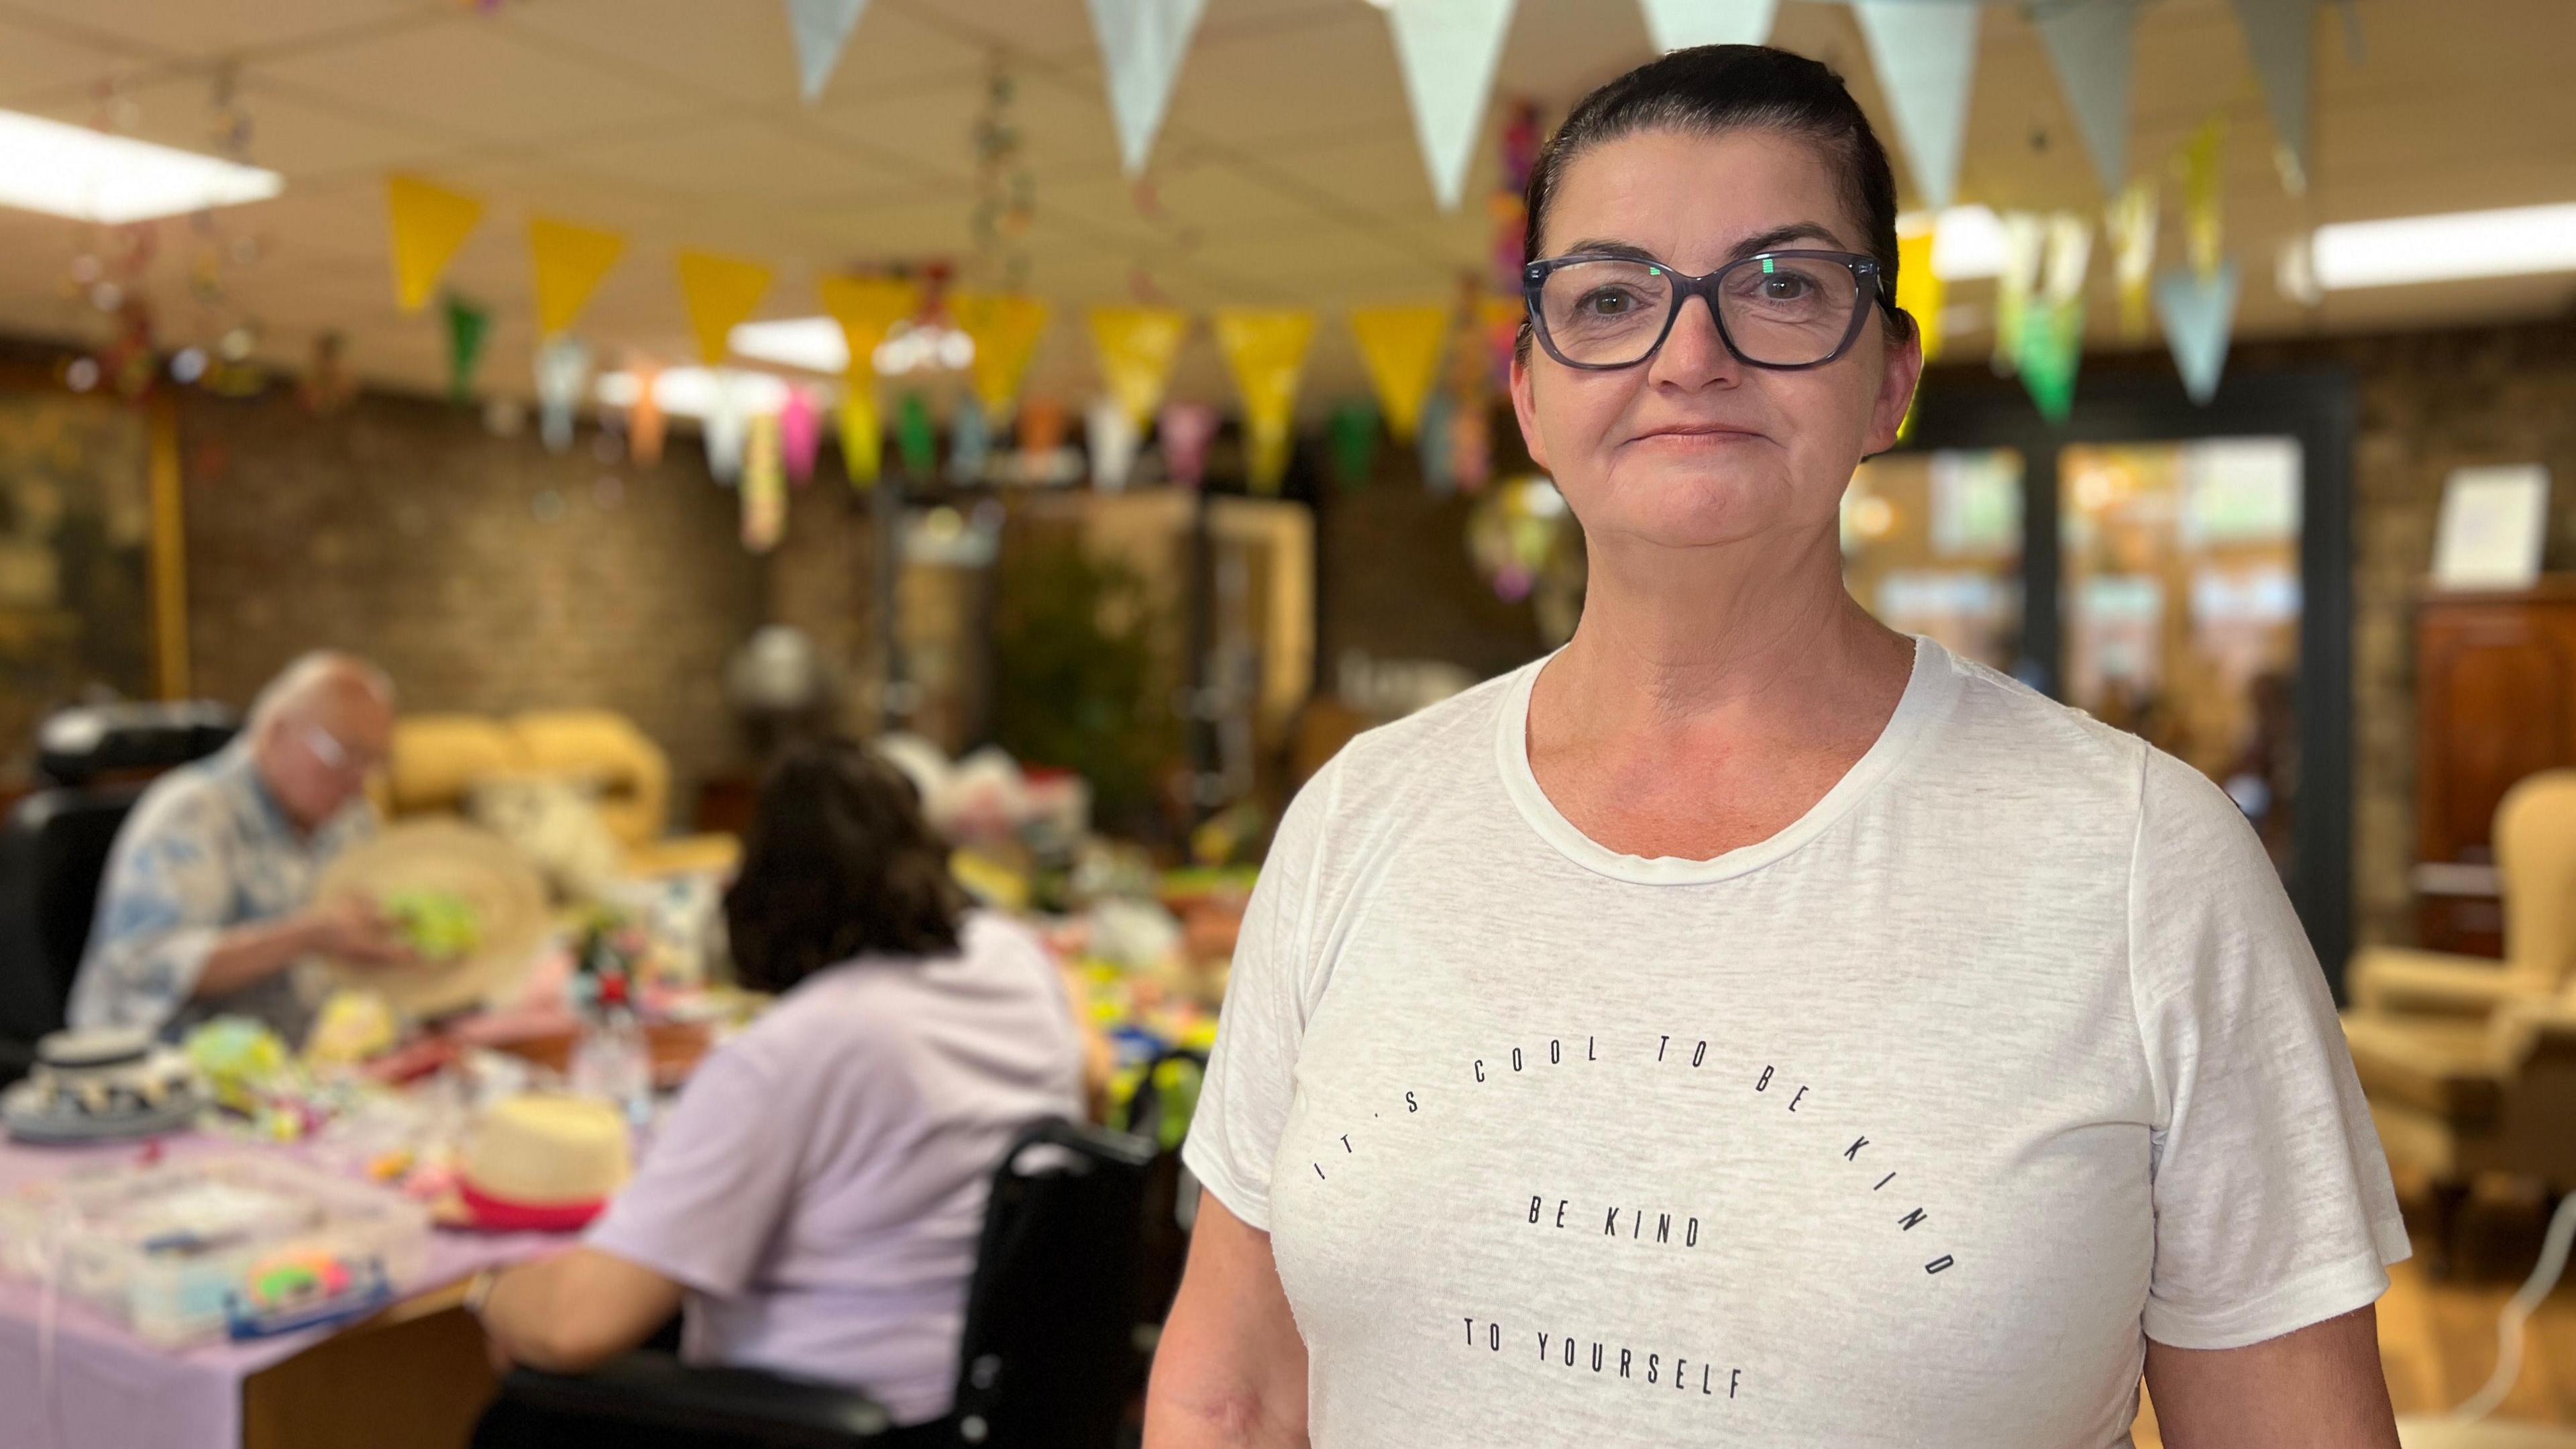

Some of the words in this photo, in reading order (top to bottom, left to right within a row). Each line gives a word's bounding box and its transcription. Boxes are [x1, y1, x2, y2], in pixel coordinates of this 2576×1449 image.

[1474, 1036, 1597, 1083] COOL
[1658, 1035, 1707, 1068] TO
[1755, 1065, 1809, 1112] BE
[1843, 1135, 1955, 1275] KIND
[1528, 1195, 1569, 1229] BE
[1604, 1207, 1699, 1248] KIND
[1463, 1317, 1500, 1352] TO
[1538, 1332, 1742, 1399] YOURSELF
